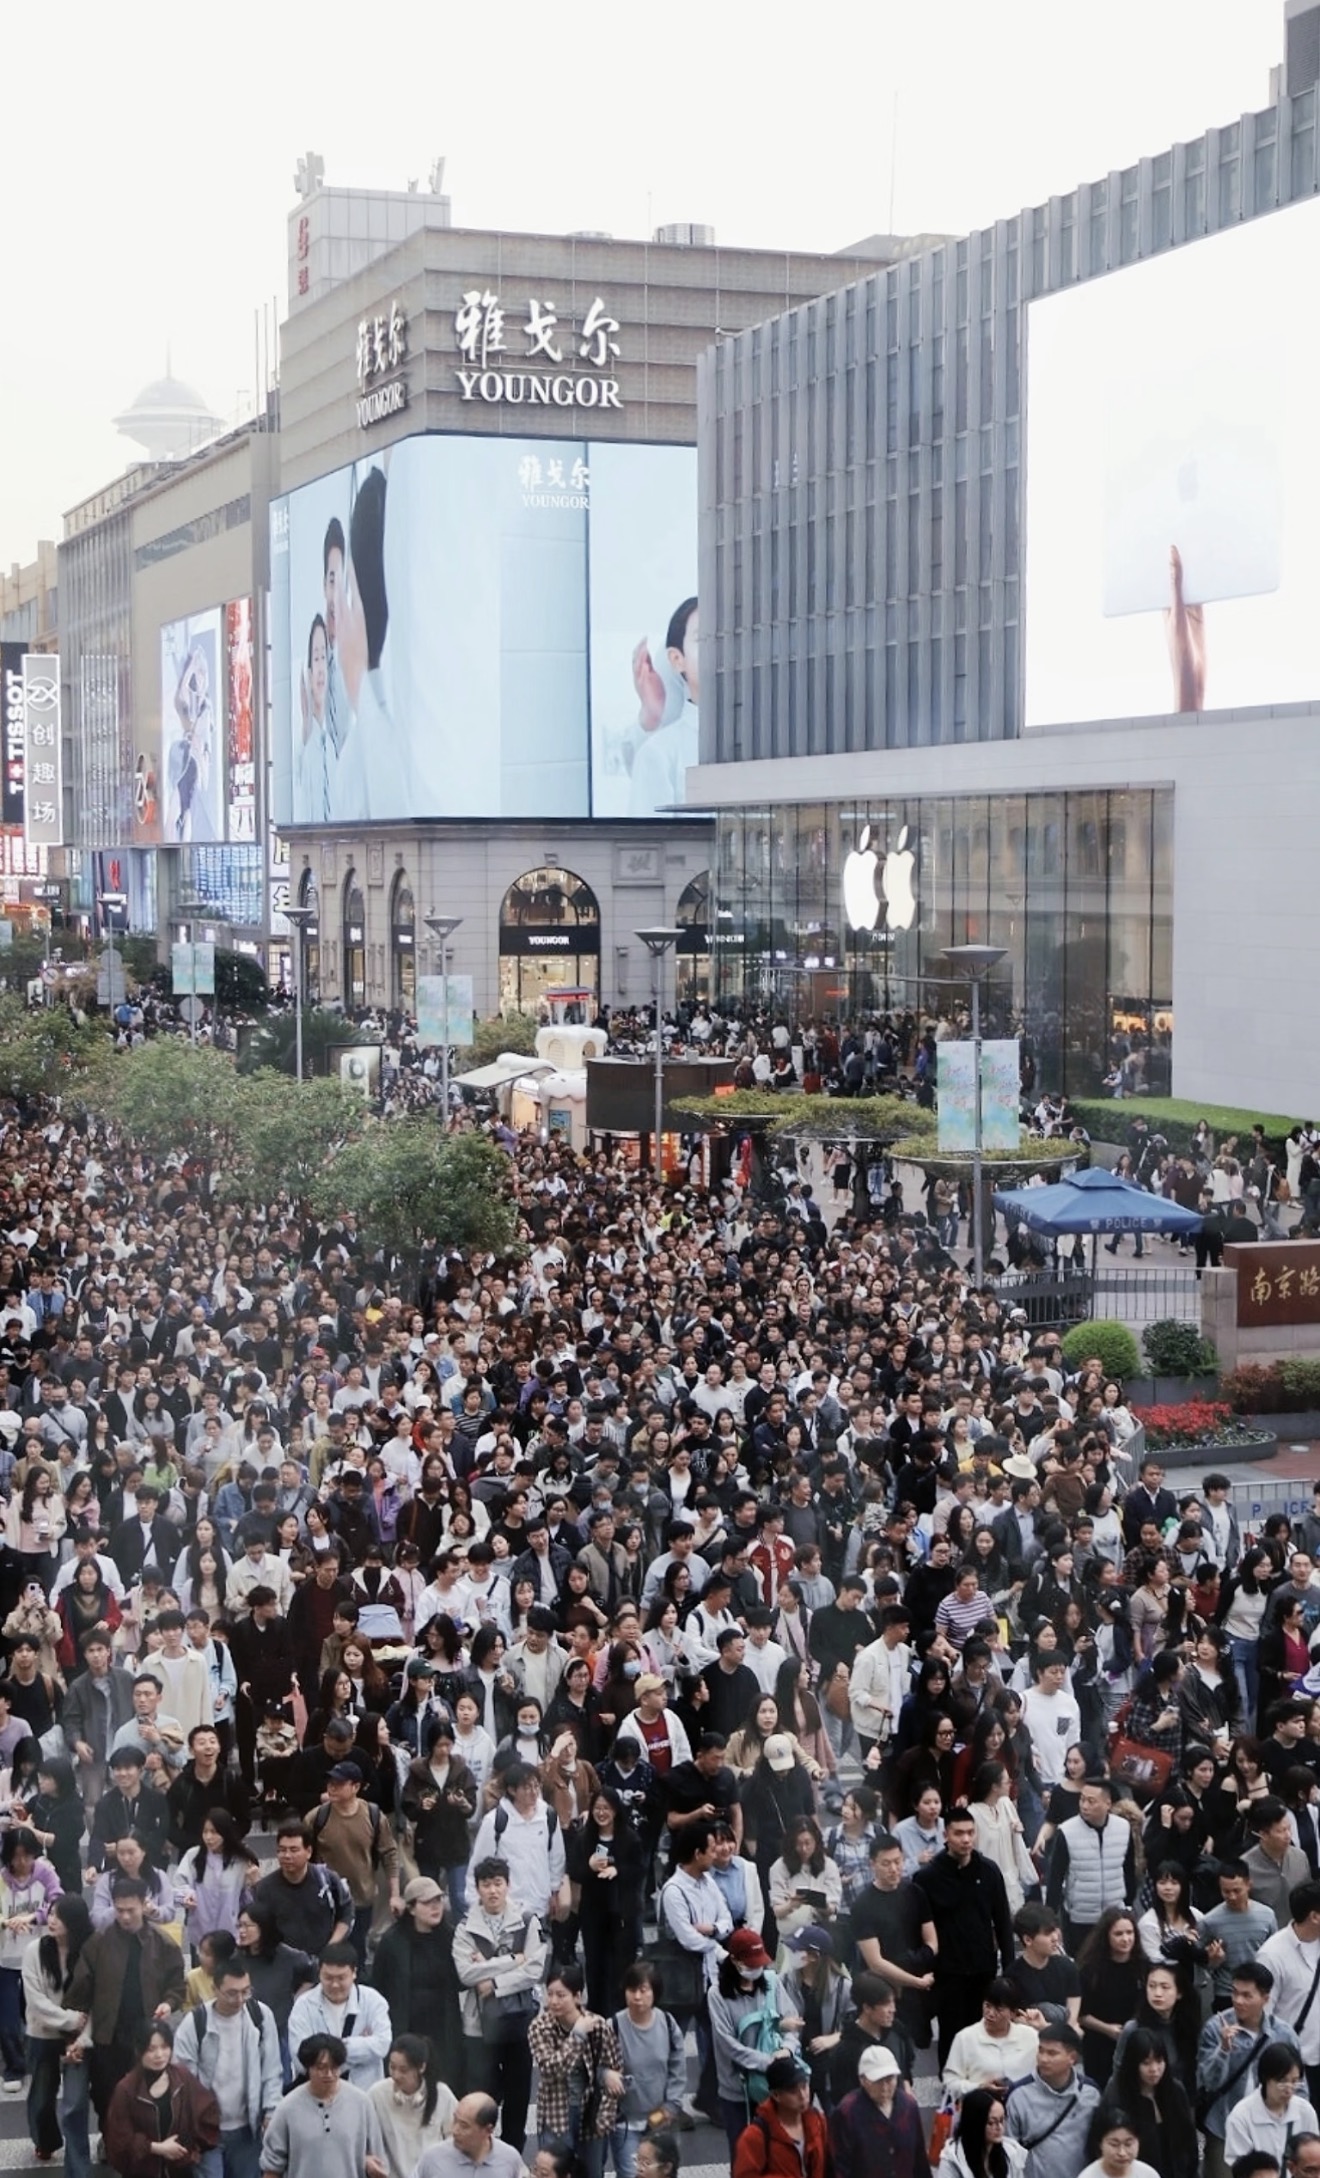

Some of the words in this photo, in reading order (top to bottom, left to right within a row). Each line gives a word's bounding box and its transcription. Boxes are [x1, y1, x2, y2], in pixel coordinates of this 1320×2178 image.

[356, 299, 407, 393] 雅戈尔
[456, 288, 621, 370] 雅戈尔
[356, 381, 405, 428] YOUNGOR
[455, 371, 624, 408] YOUNGOR
[518, 454, 590, 493] 雅戈尔
[523, 493, 590, 510] YOUNGOR
[32, 723, 56, 824] 创趣场
[1106, 1218, 1147, 1229] POLICE
[1251, 1265, 1320, 1307] 南京路
